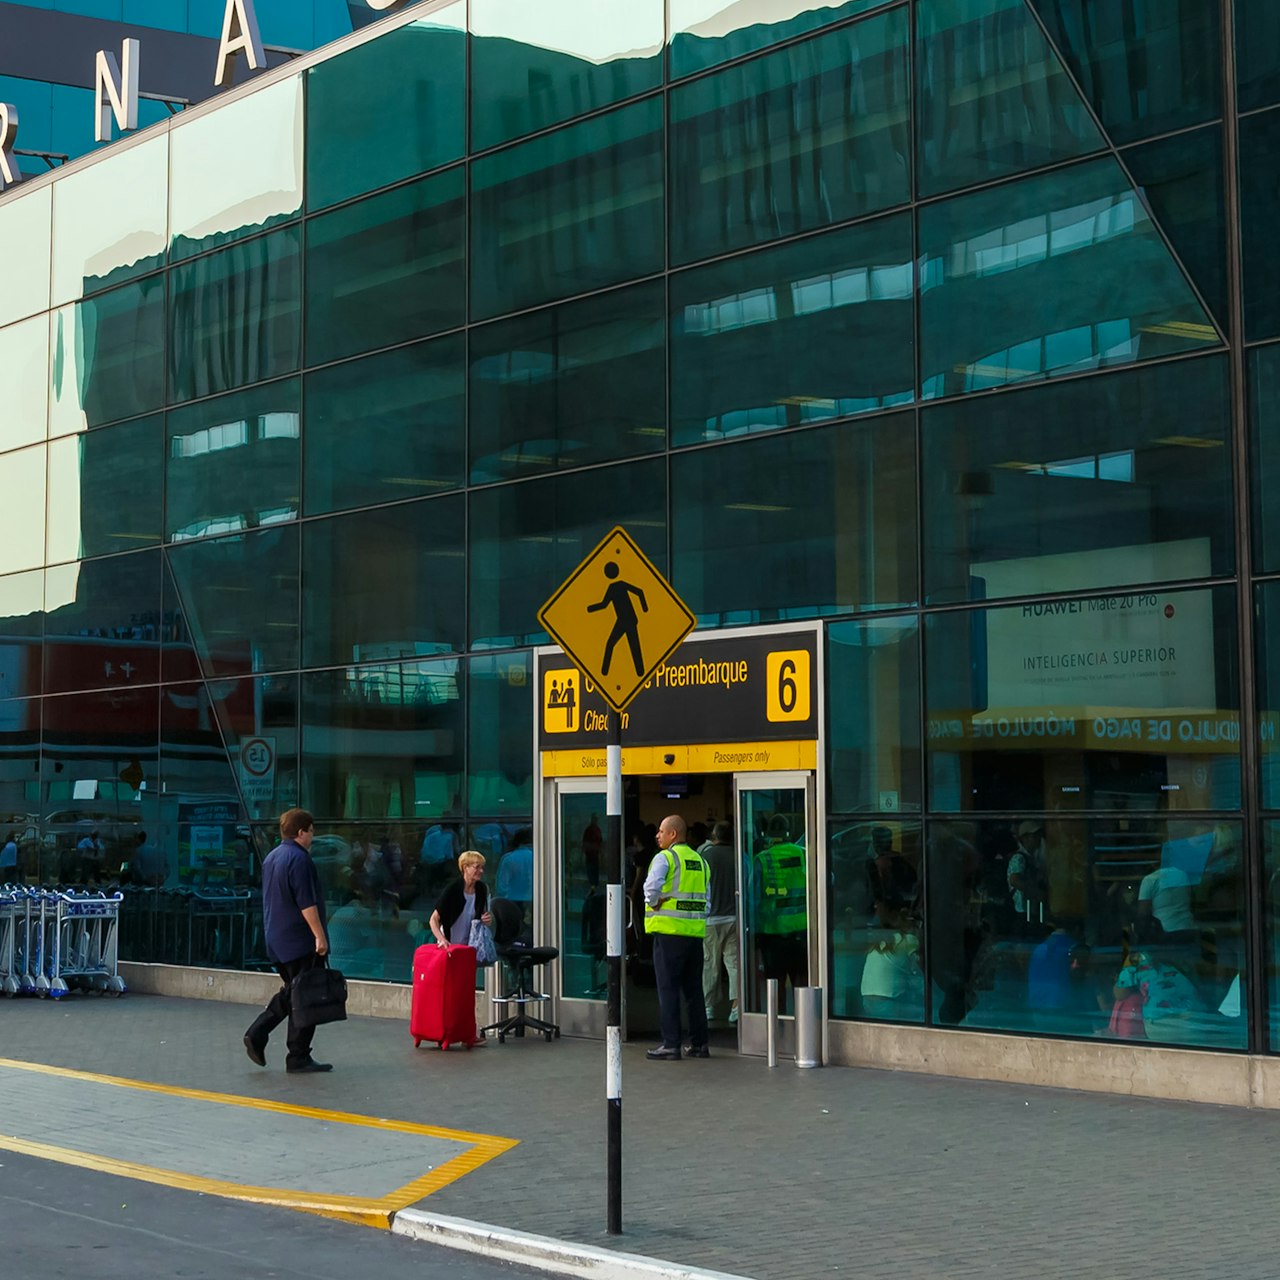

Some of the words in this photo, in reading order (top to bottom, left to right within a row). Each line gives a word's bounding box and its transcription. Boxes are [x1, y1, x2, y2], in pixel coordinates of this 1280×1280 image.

[1023, 652, 1108, 671] INTELIGENCIA
[1113, 646, 1177, 665] SUPERIOR
[655, 657, 748, 689] Preembarque
[778, 659, 797, 713] 6
[713, 751, 753, 764] Passengers
[754, 750, 771, 764] only
